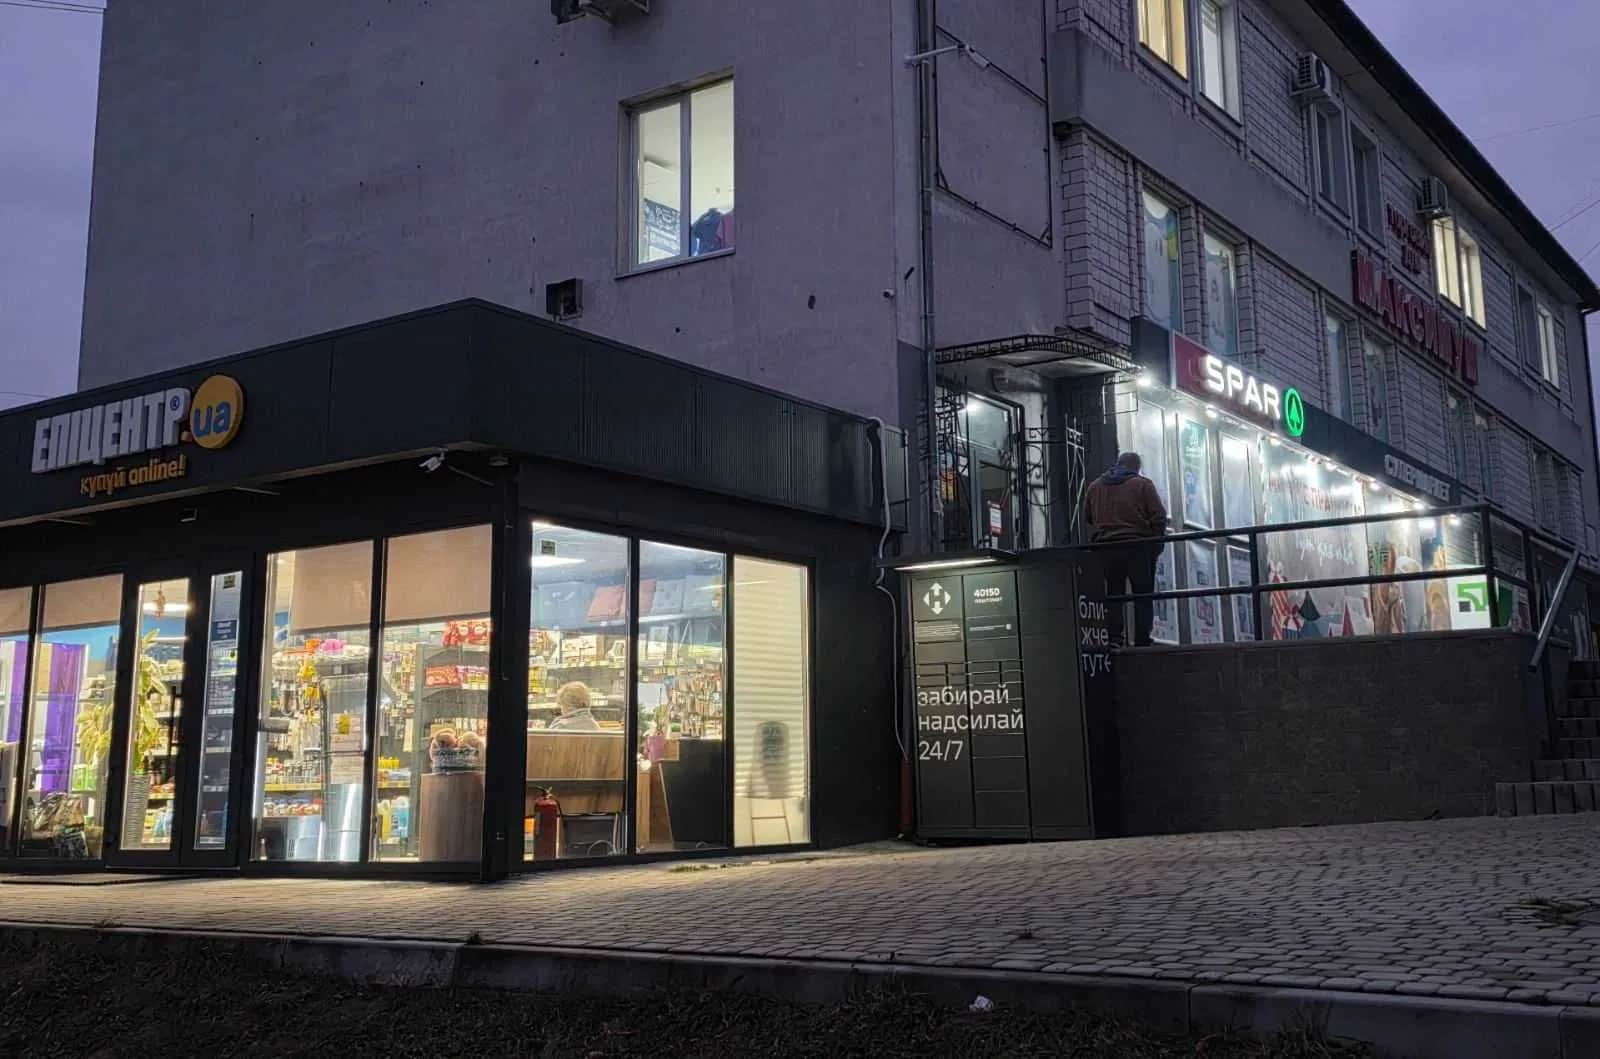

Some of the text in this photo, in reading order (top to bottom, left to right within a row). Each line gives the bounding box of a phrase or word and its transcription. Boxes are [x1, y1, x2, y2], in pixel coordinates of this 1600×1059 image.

[1202, 354, 1281, 420] SPAR
[80, 454, 187, 497] купуй online!
[974, 587, 1001, 598] 40150
[1079, 595, 1109, 620] бли-
[1081, 627, 1109, 646] жче
[917, 684, 1009, 709] забирай
[918, 708, 1024, 733] надсилай
[919, 740, 964, 761] 24/7
